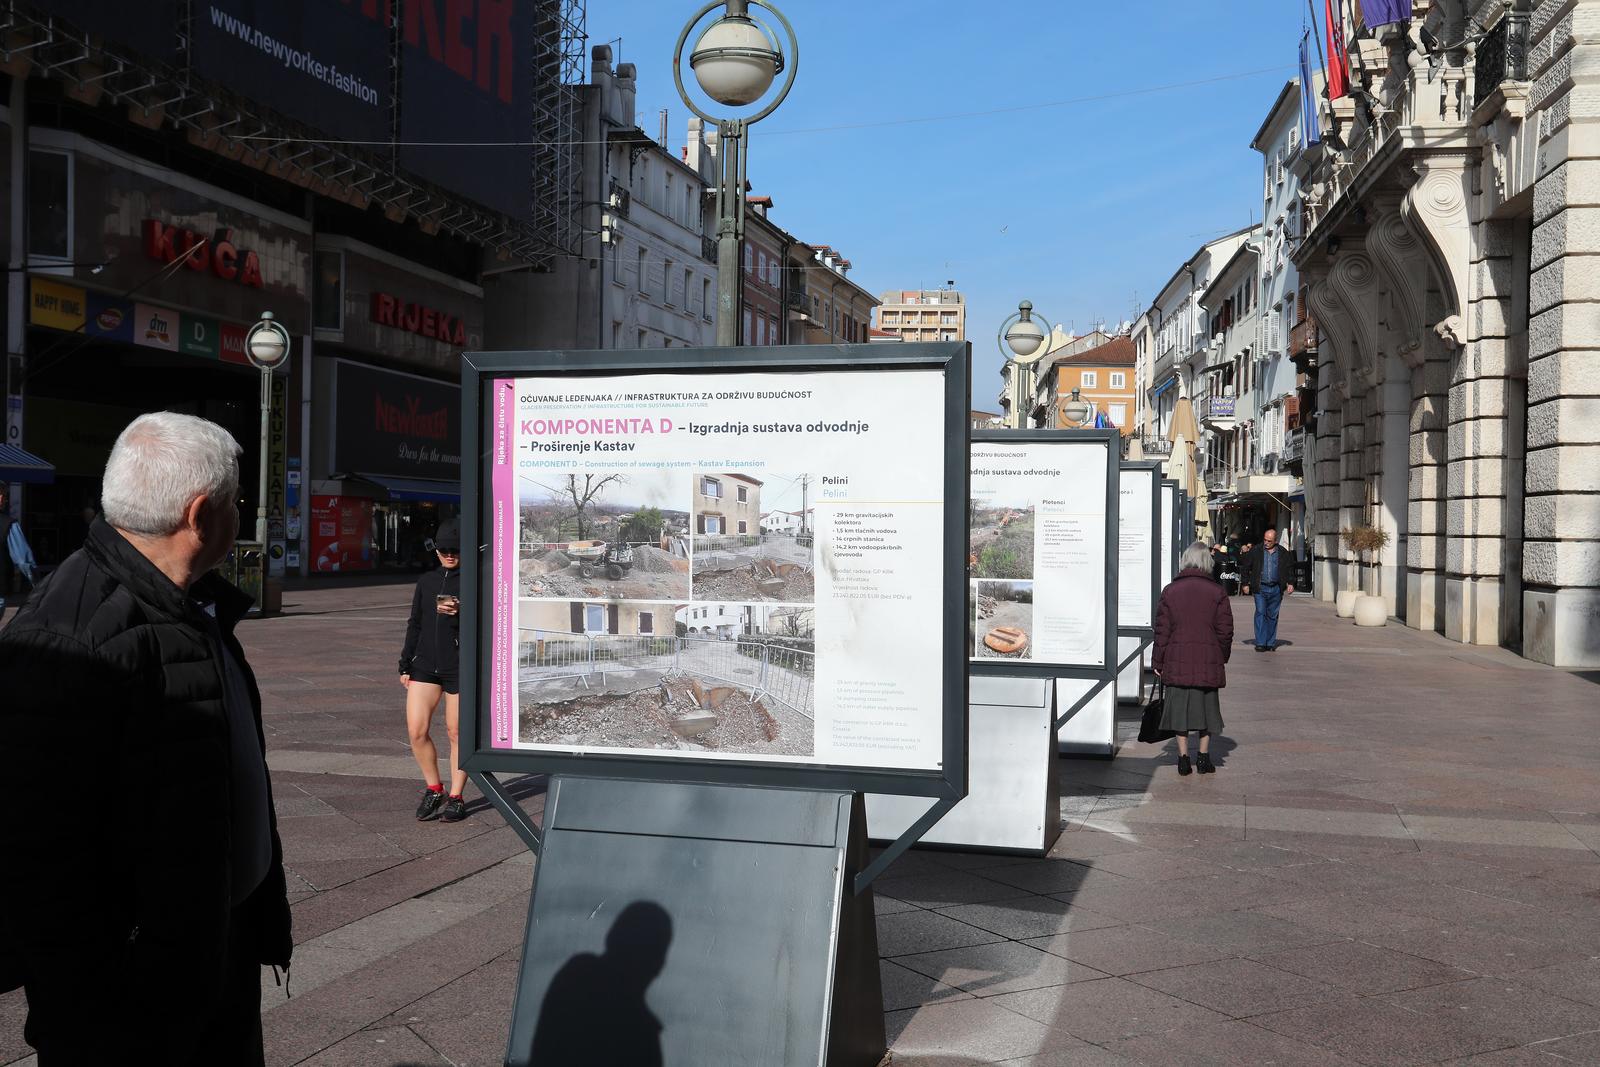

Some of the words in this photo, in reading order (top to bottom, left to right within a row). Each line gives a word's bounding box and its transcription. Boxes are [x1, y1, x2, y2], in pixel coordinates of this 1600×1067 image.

[210, 5, 378, 106] www.newyorker.fashion
[142, 218, 264, 289] KUĆA
[150, 313, 167, 332] dm
[369, 291, 467, 347] RIJEKA
[520, 393, 564, 403] OČUVANJE
[565, 393, 613, 402] LEDENJAKA
[624, 392, 699, 401] INFRASTRUKTURA
[701, 392, 714, 401] ZA
[715, 391, 755, 400] ODRŽIVU
[756, 390, 813, 400] BUDUĆNOST
[271, 380, 284, 445] OTKUP
[499, 430, 505, 440] za
[521, 418, 654, 435] KOMPONENTA
[660, 418, 673, 434] D
[689, 421, 749, 436] Izgradnja
[752, 422, 803, 433] sustava
[806, 420, 869, 434] odvodnje
[497, 440, 505, 465] Rijeka
[531, 441, 591, 454] Proširenje
[594, 441, 635, 452] Kastav
[520, 460, 571, 468] COMPONENT
[572, 460, 578, 468] D
[584, 460, 628, 468] Construction
[638, 461, 666, 470] sewage
[666, 461, 692, 469] system
[698, 460, 724, 468] Kastav
[725, 459, 765, 469] Expansion
[1023, 468, 1061, 477] odvodnje
[271, 452, 284, 517] ZLATA
[822, 476, 848, 485] Pelini
[823, 489, 848, 498] Pelini
